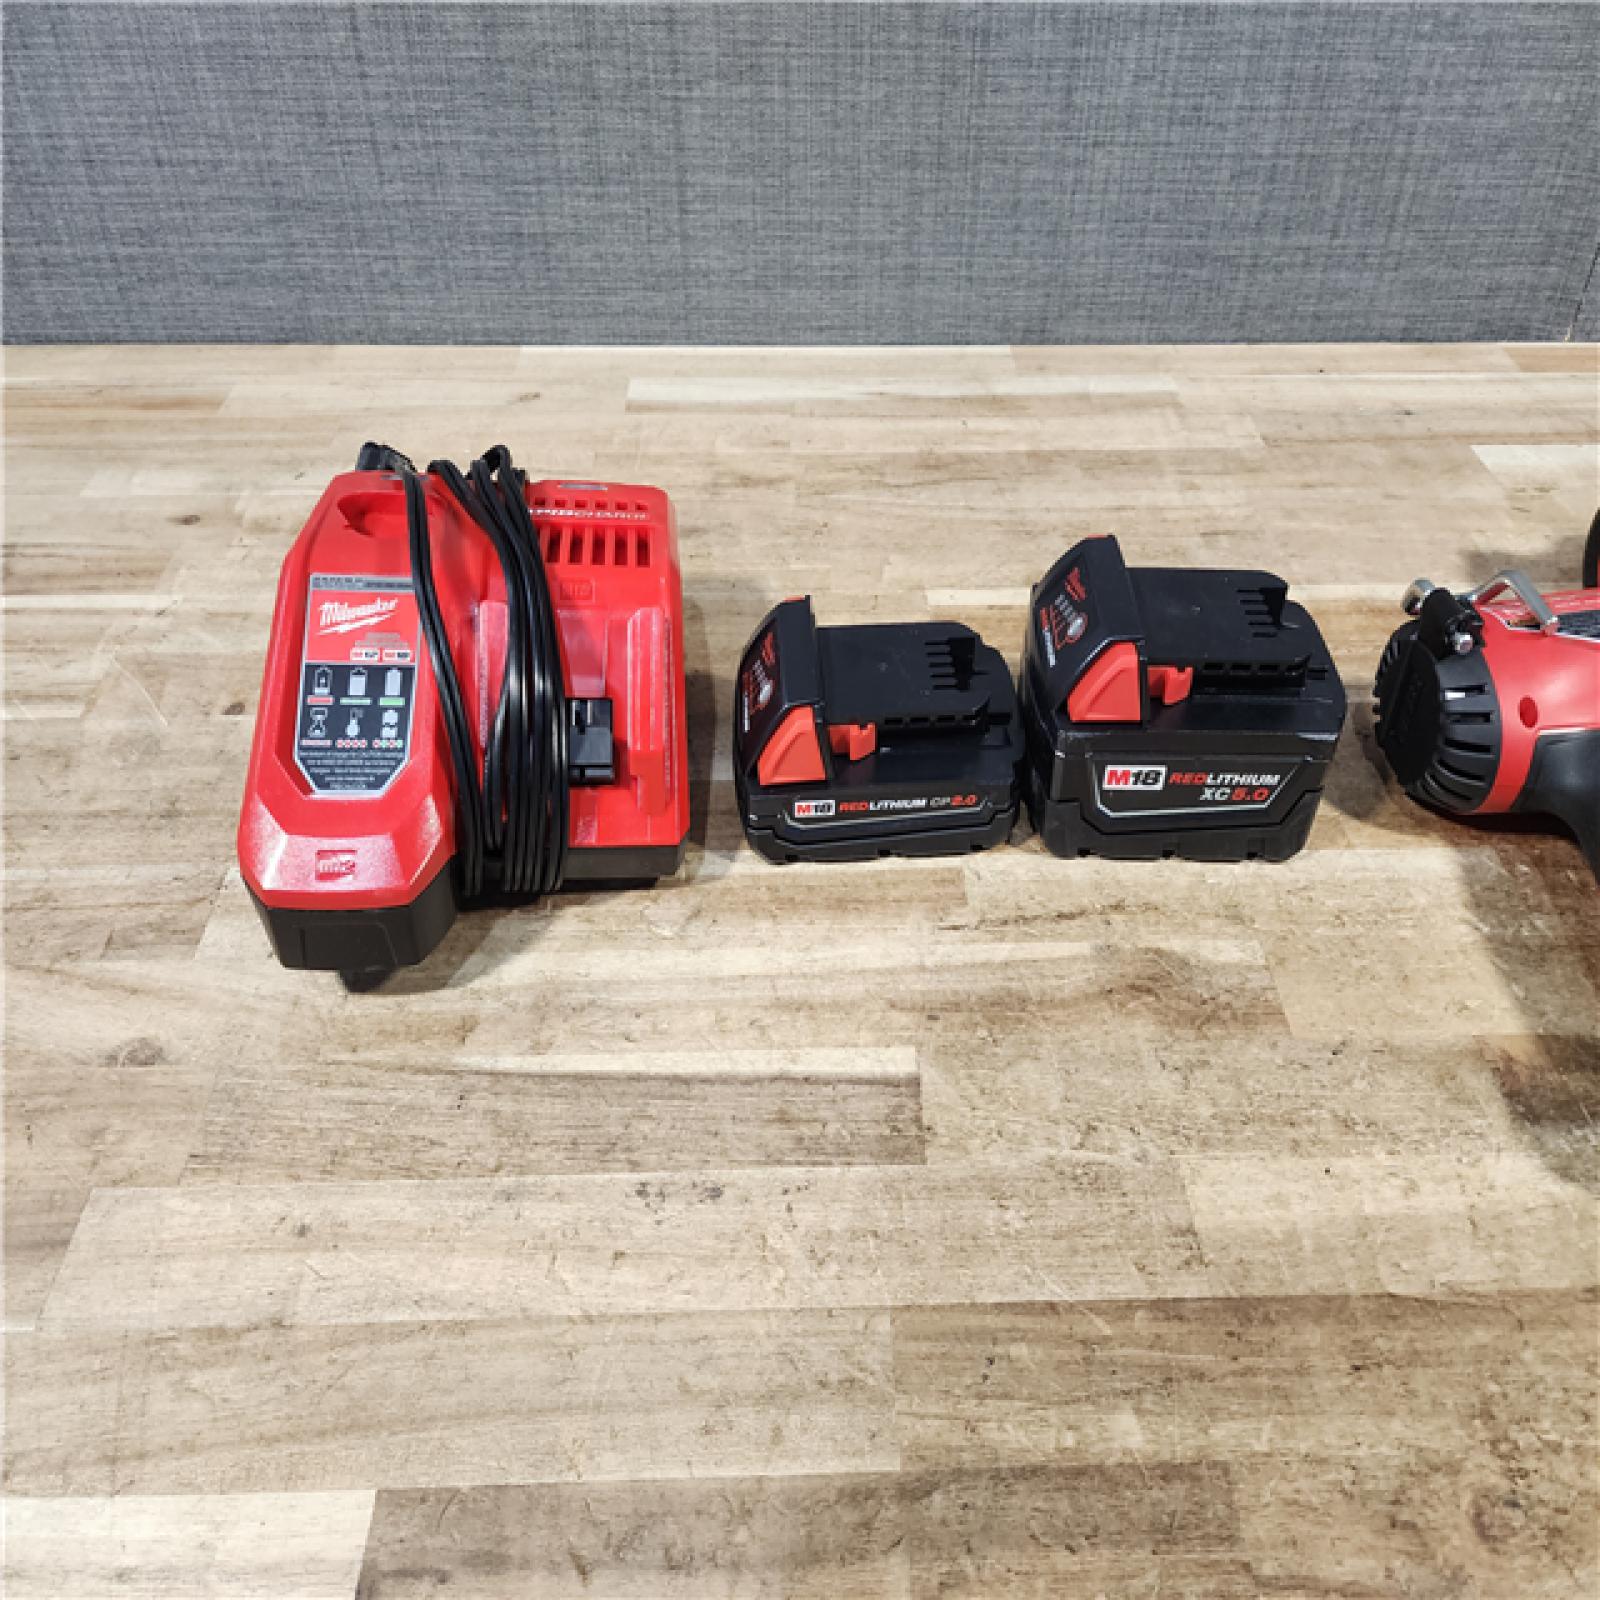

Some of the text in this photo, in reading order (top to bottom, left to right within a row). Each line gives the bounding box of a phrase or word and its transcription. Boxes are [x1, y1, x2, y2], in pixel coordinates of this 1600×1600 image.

[318, 597, 399, 626] Milwaukee
[1105, 768, 1281, 787] M18 REDLITHIUM
[796, 802, 833, 816] M18
[839, 798, 928, 812] REDLITHIUM
